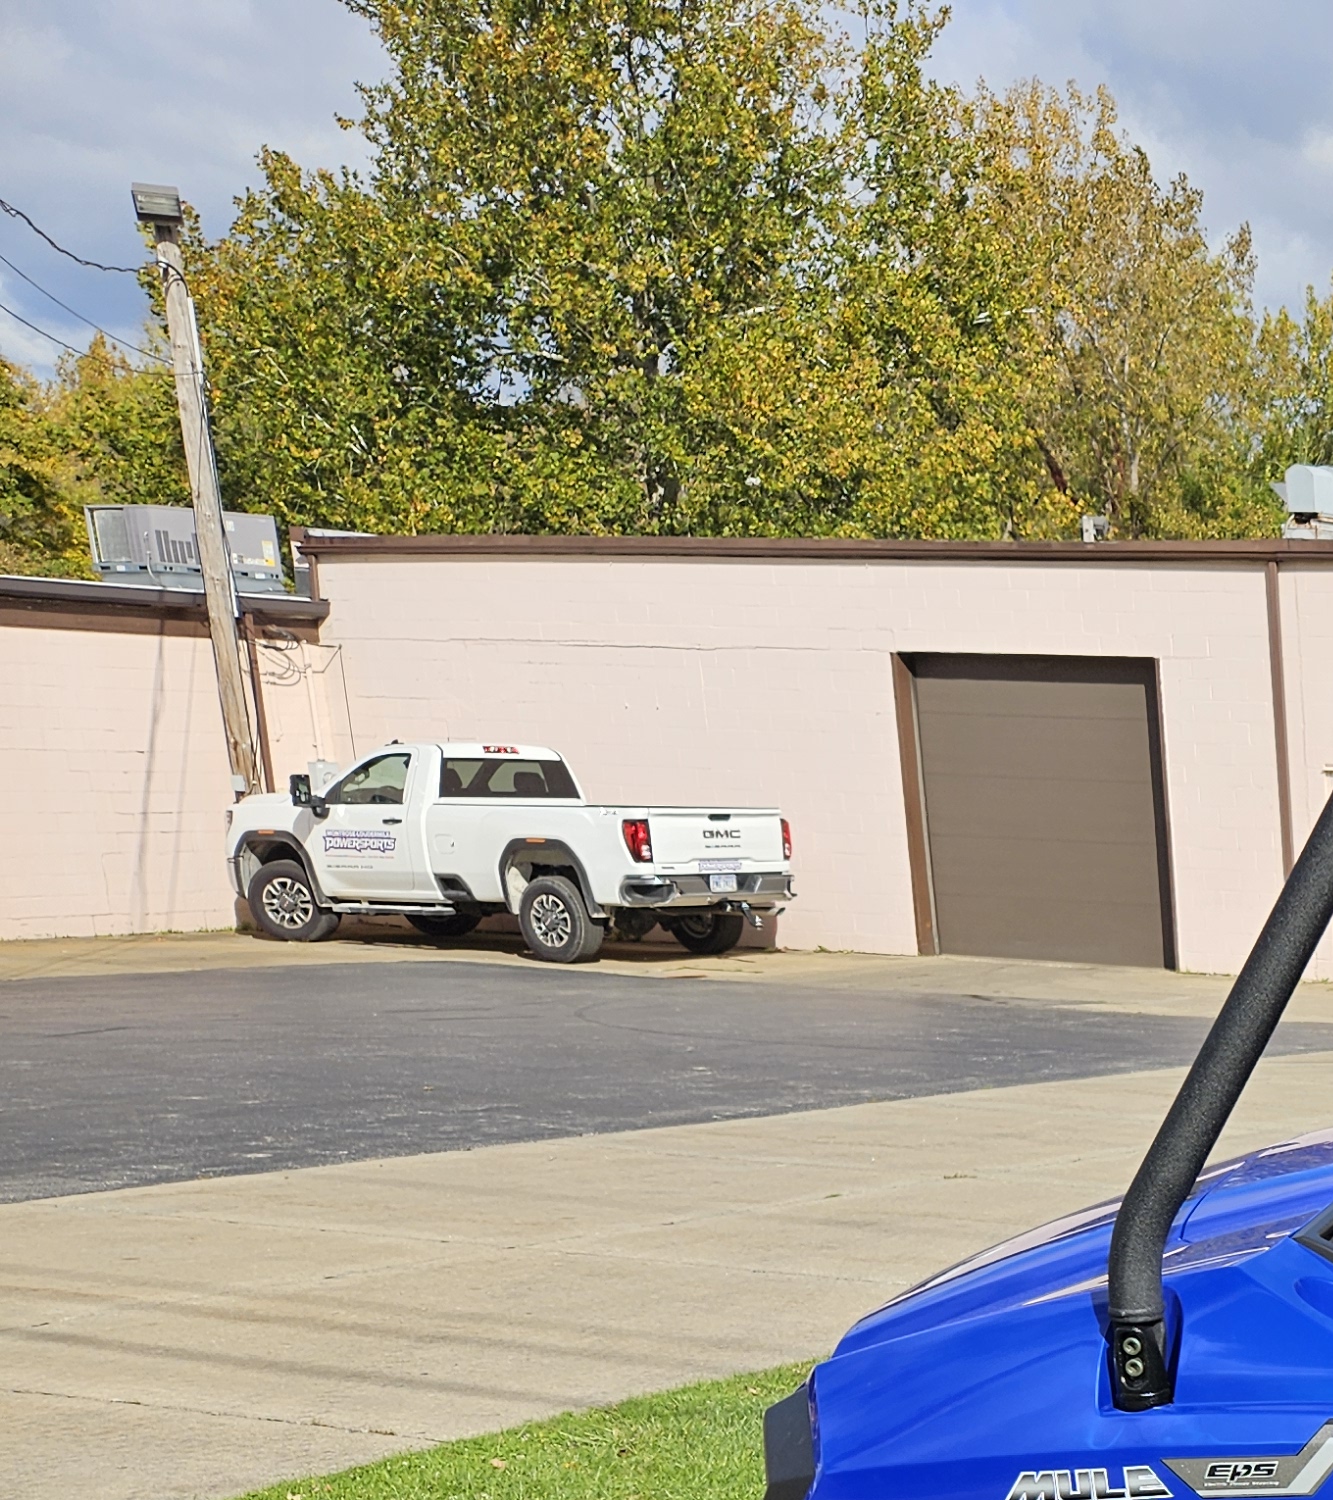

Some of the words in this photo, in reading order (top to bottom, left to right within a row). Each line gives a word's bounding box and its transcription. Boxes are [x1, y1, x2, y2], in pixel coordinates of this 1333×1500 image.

[702, 829, 741, 839] GMC
[323, 835, 396, 853] POWERSPORTS
[1204, 1461, 1280, 1483] EPS
